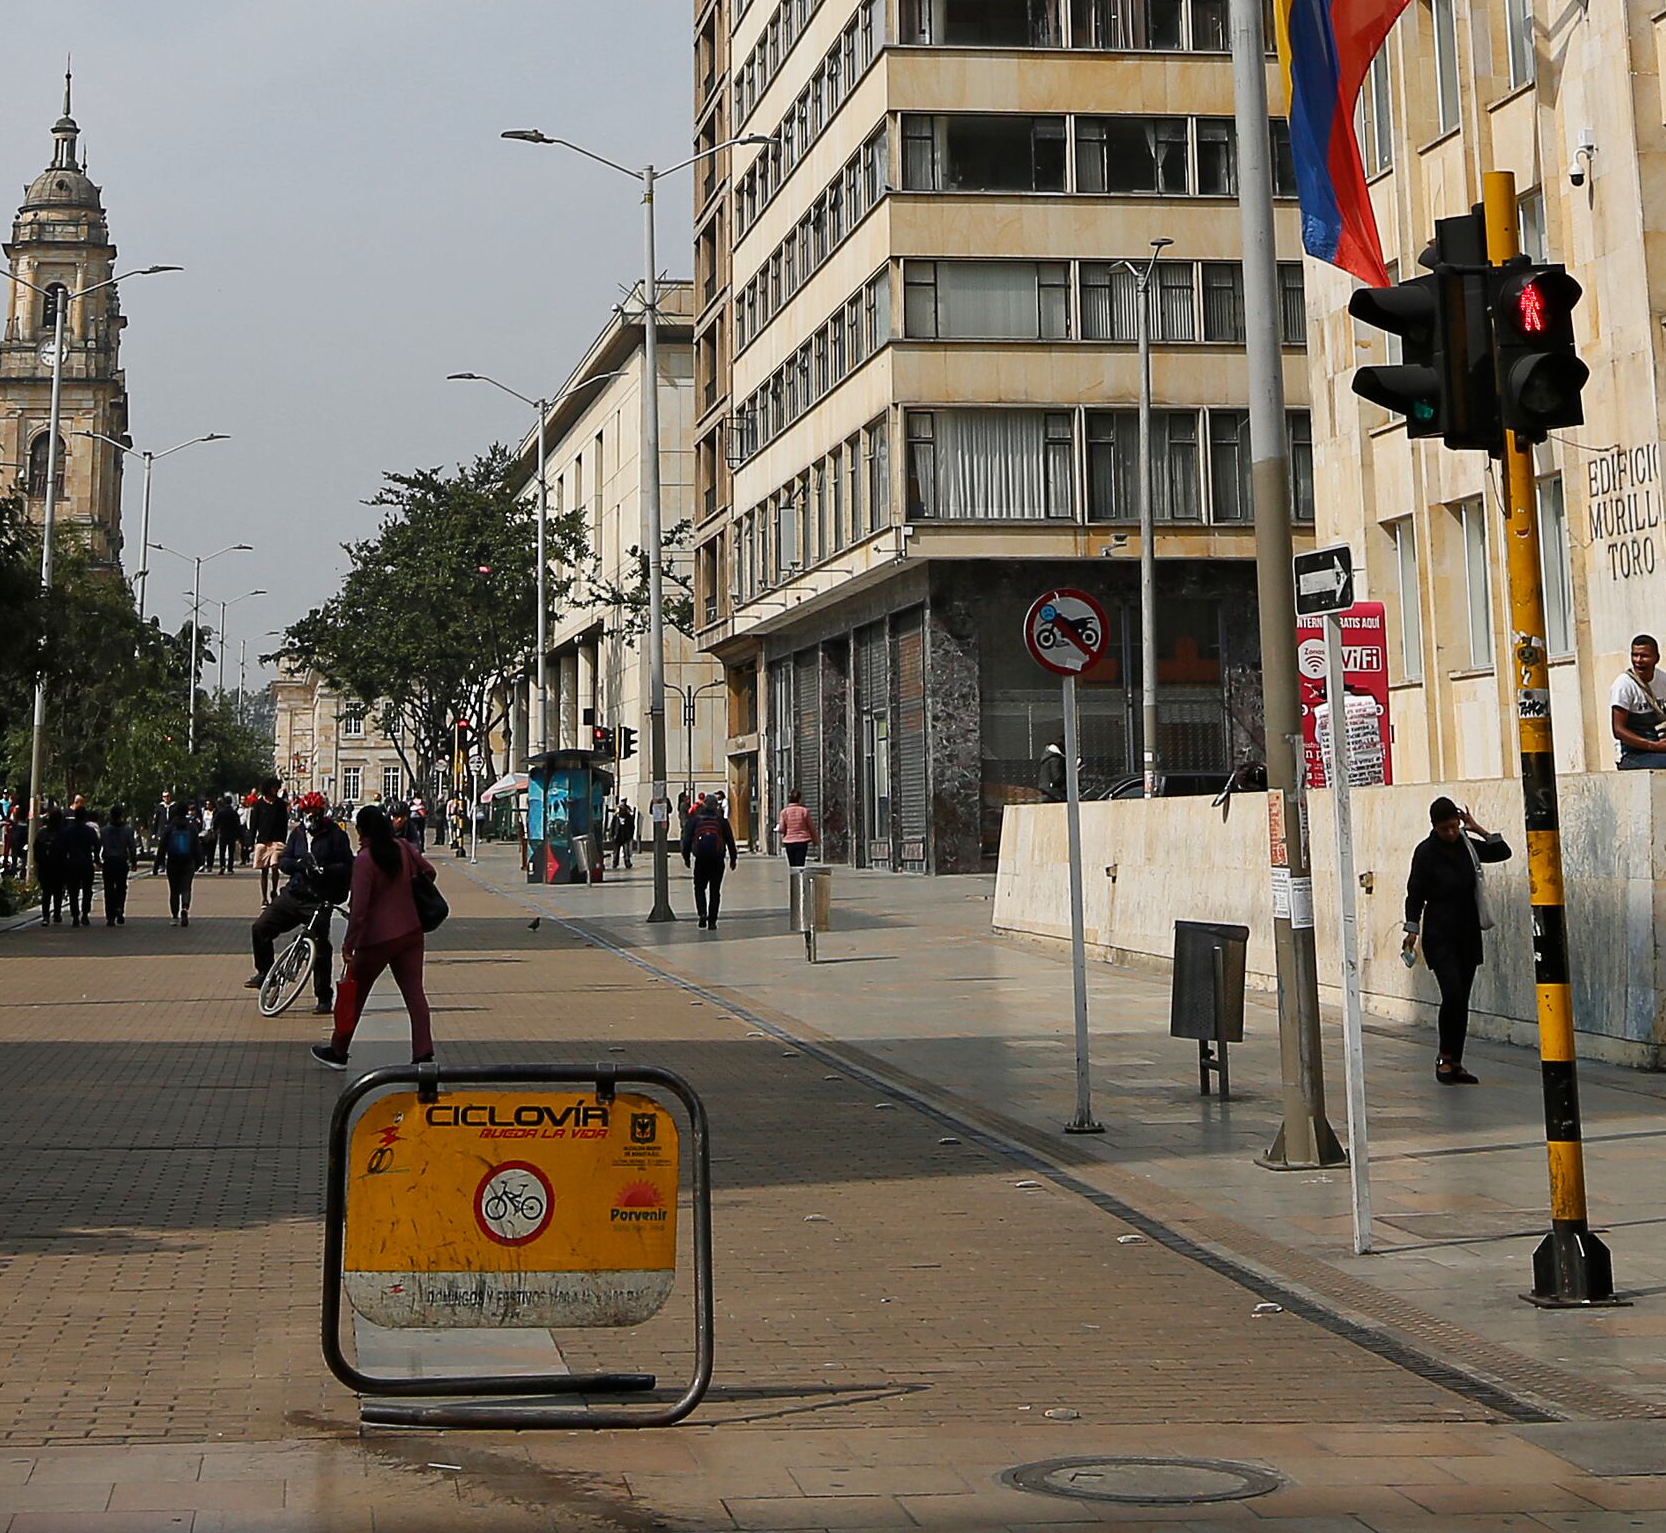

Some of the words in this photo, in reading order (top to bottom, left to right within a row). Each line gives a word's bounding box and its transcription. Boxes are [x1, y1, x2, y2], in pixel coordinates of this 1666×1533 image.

[1588, 490, 1661, 541] MURILL
[1608, 536, 1655, 581] TORO
[1339, 617, 1360, 628] RATIS
[1362, 615, 1380, 628] AQUÍ
[1304, 648, 1325, 656] Zonas
[425, 1100, 609, 1127] CICLOVÍA
[479, 1129, 537, 1139] RUEDA
[541, 1129, 566, 1139] LA
[571, 1129, 609, 1139] VIDA
[610, 1208, 668, 1222] Porvenir
